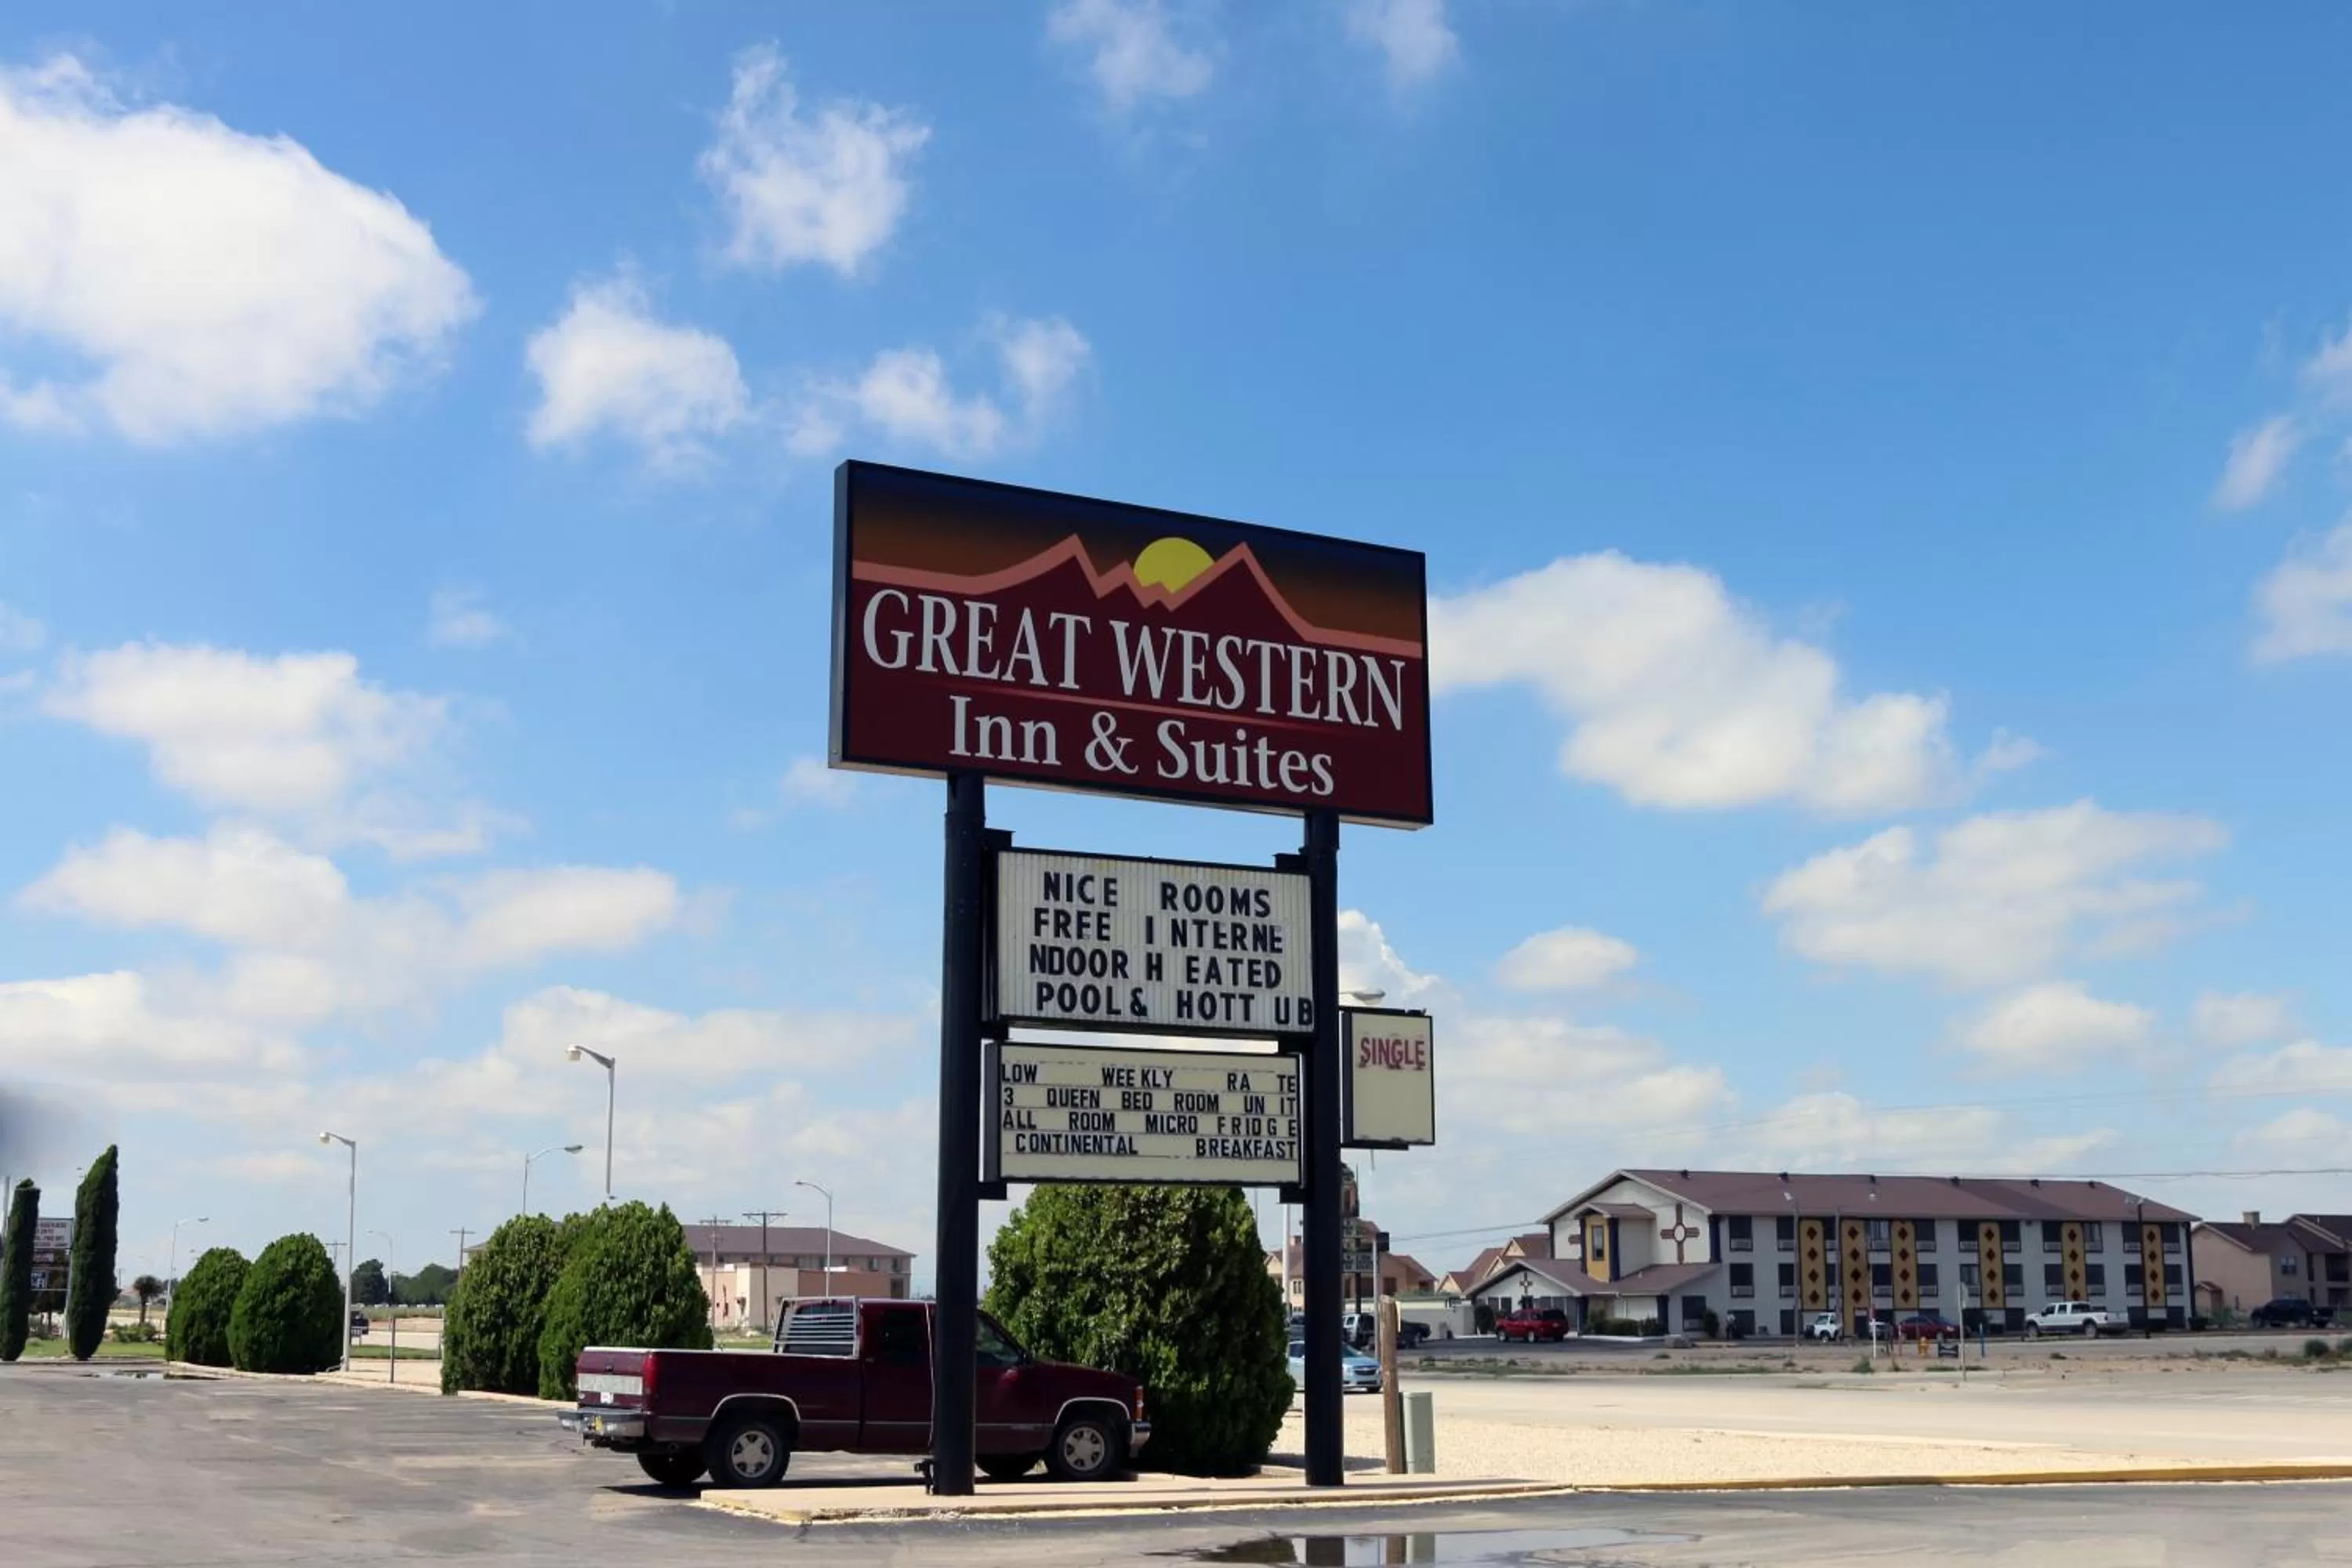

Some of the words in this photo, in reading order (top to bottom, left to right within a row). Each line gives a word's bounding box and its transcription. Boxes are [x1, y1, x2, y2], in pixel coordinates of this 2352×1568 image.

[862, 588, 1091, 690] GREAT
[1108, 619, 1406, 731] WESTERN
[948, 694, 1062, 767] Inn
[1083, 710, 1138, 775] &
[1156, 720, 1334, 796] Suites
[1044, 871, 1117, 906] NICE
[1160, 881, 1271, 918] ROOMS
[1034, 907, 1111, 941] FREE
[1029, 943, 1130, 979] NDOOR
[1359, 1036, 1426, 1069] SINGLE
[1000, 1064, 1037, 1083] LOW
[1102, 1067, 1173, 1088] WEEKLY
[1004, 1087, 1014, 1106] 3
[1121, 1091, 1152, 1111] BED
[1174, 1092, 1219, 1113] ROOM
[1003, 1110, 1036, 1130] ALL
[1069, 1111, 1115, 1132] ROOM
[1145, 1114, 1198, 1134] MICRO
[1015, 1133, 1138, 1155] CONTINENTAL
[1196, 1138, 1296, 1160] BREAKFAST
